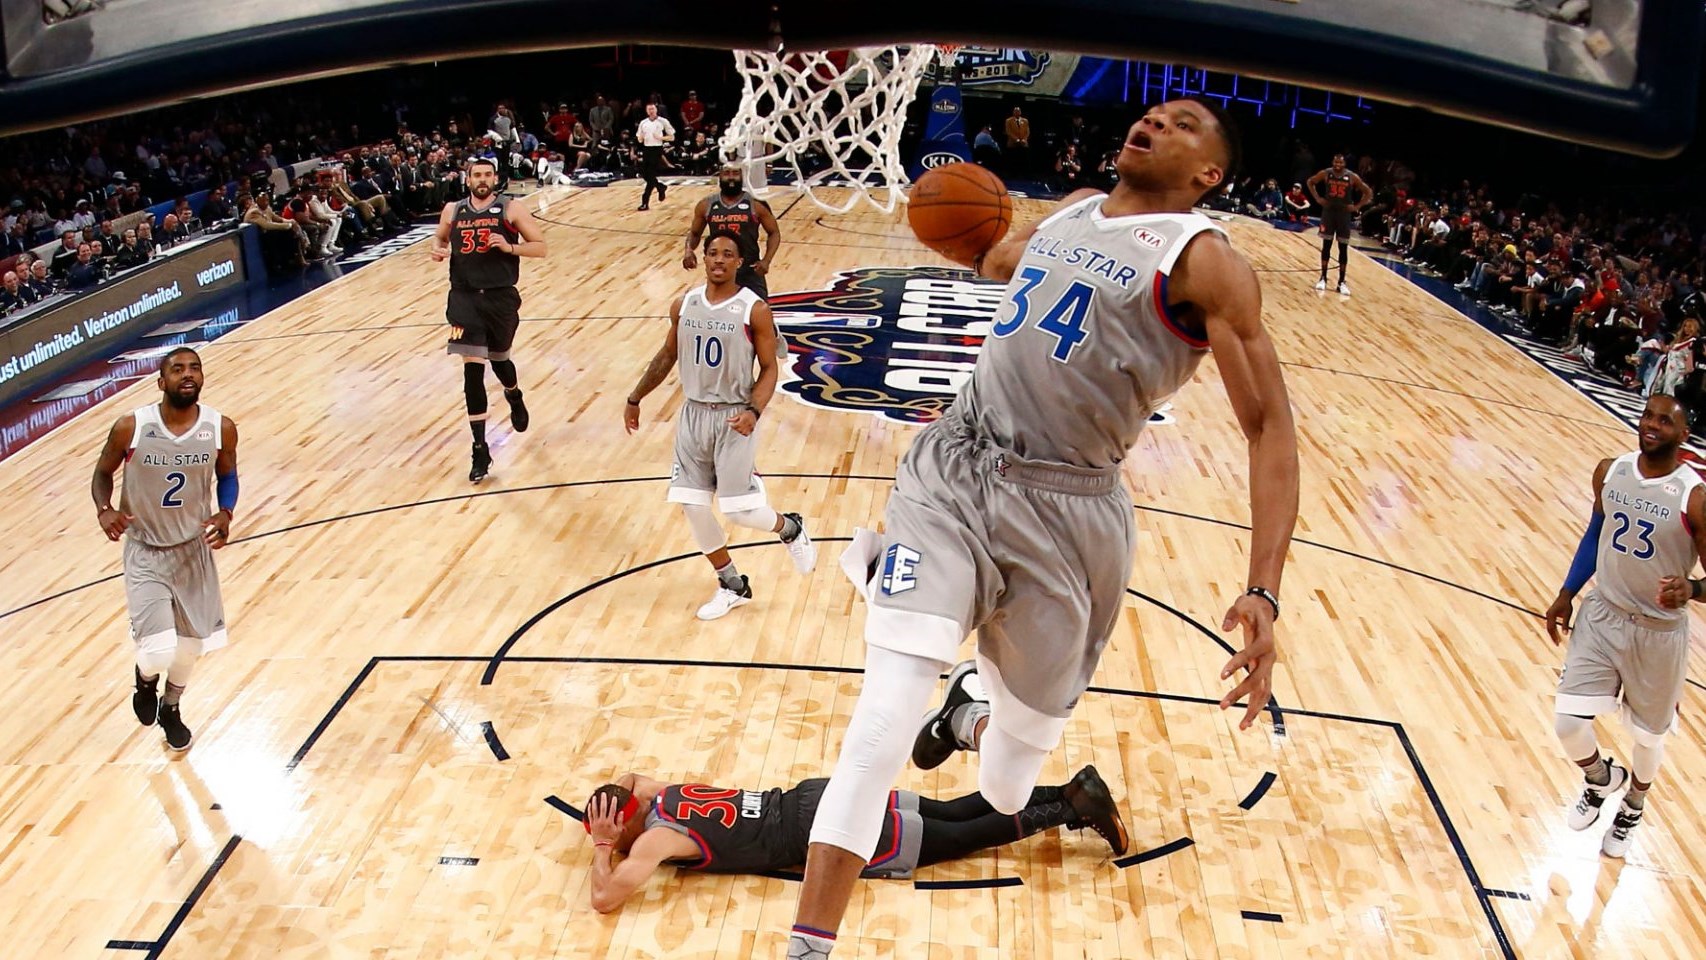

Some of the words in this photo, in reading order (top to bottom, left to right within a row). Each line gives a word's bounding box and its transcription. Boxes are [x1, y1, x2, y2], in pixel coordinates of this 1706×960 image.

[457, 218, 499, 228] ALL-STAR
[1138, 231, 1162, 248] KIA
[461, 228, 490, 254] 33
[196, 259, 234, 287] verizon
[1029, 236, 1137, 288] ALL-STAR
[19, 325, 84, 371] unlimited.
[83, 311, 130, 338] Verizon
[128, 280, 182, 318] unlimited.
[992, 265, 1098, 364] 34
[695, 335, 723, 369] 10
[161, 471, 187, 508] 2
[1612, 511, 1656, 560] 23
[677, 784, 739, 829] 30
[741, 791, 762, 818] CURRY
